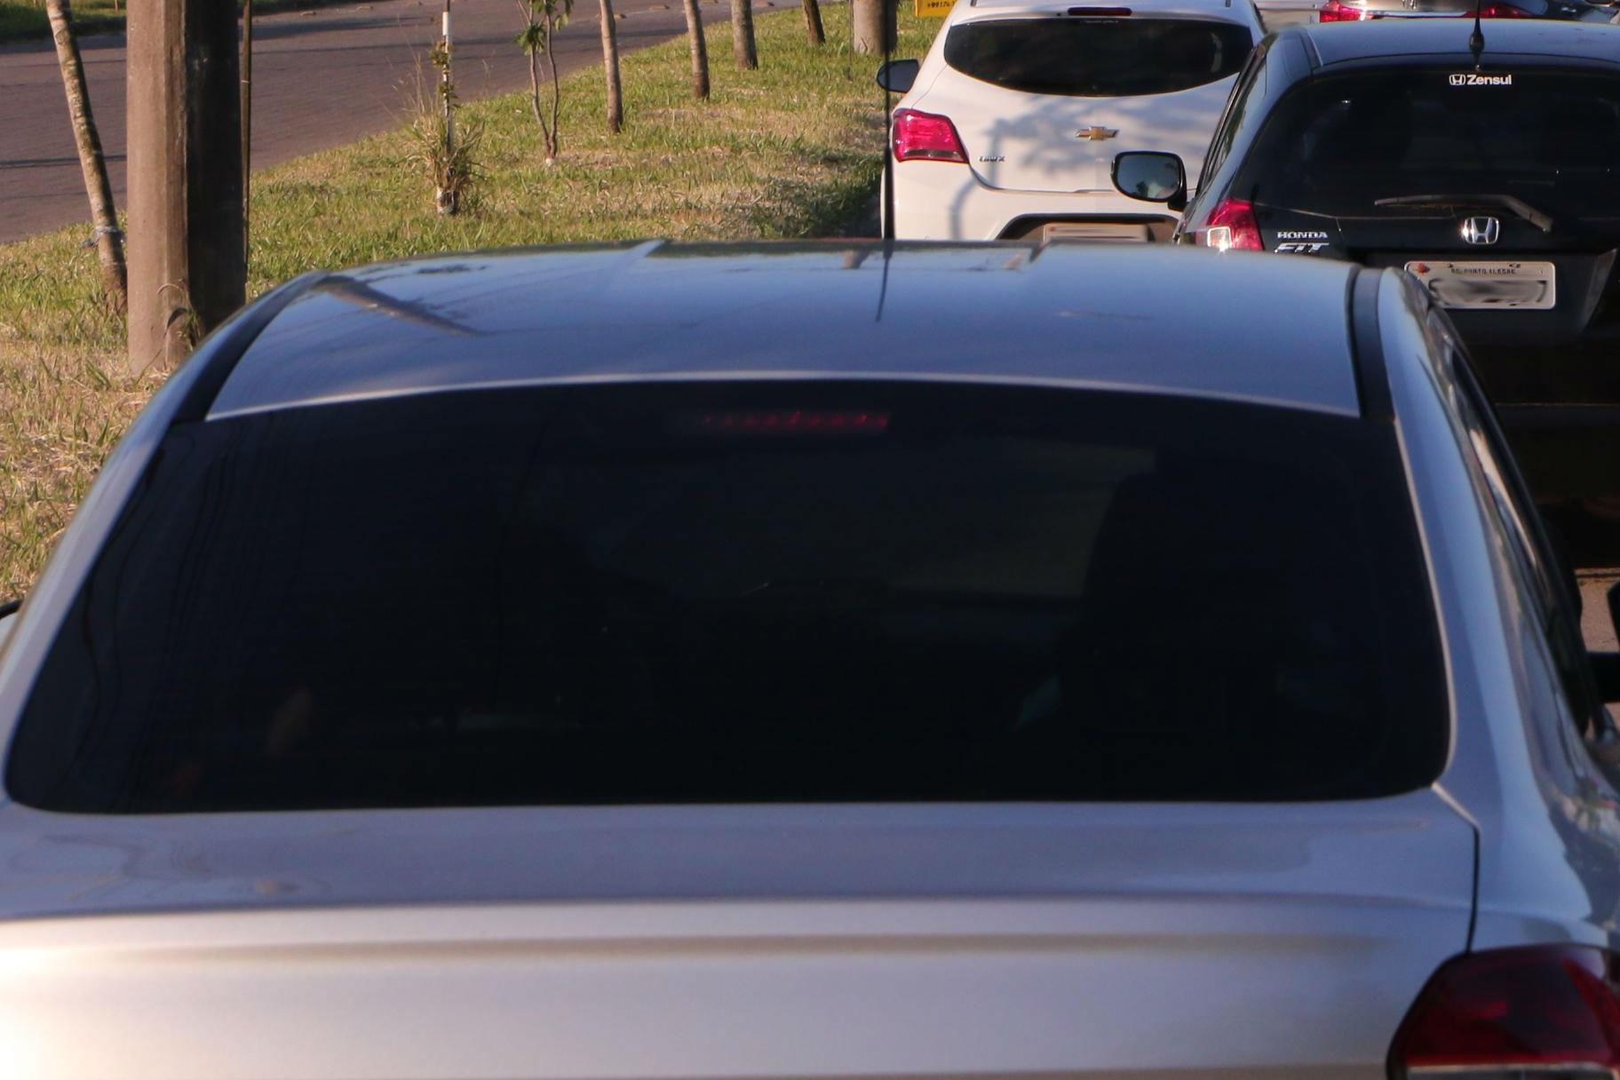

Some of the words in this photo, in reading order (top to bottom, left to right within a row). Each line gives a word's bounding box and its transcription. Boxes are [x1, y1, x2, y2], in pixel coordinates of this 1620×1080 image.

[1466, 74, 1512, 86] Zensul
[1277, 231, 1328, 239] HONDA
[1274, 242, 1330, 254] FIT
